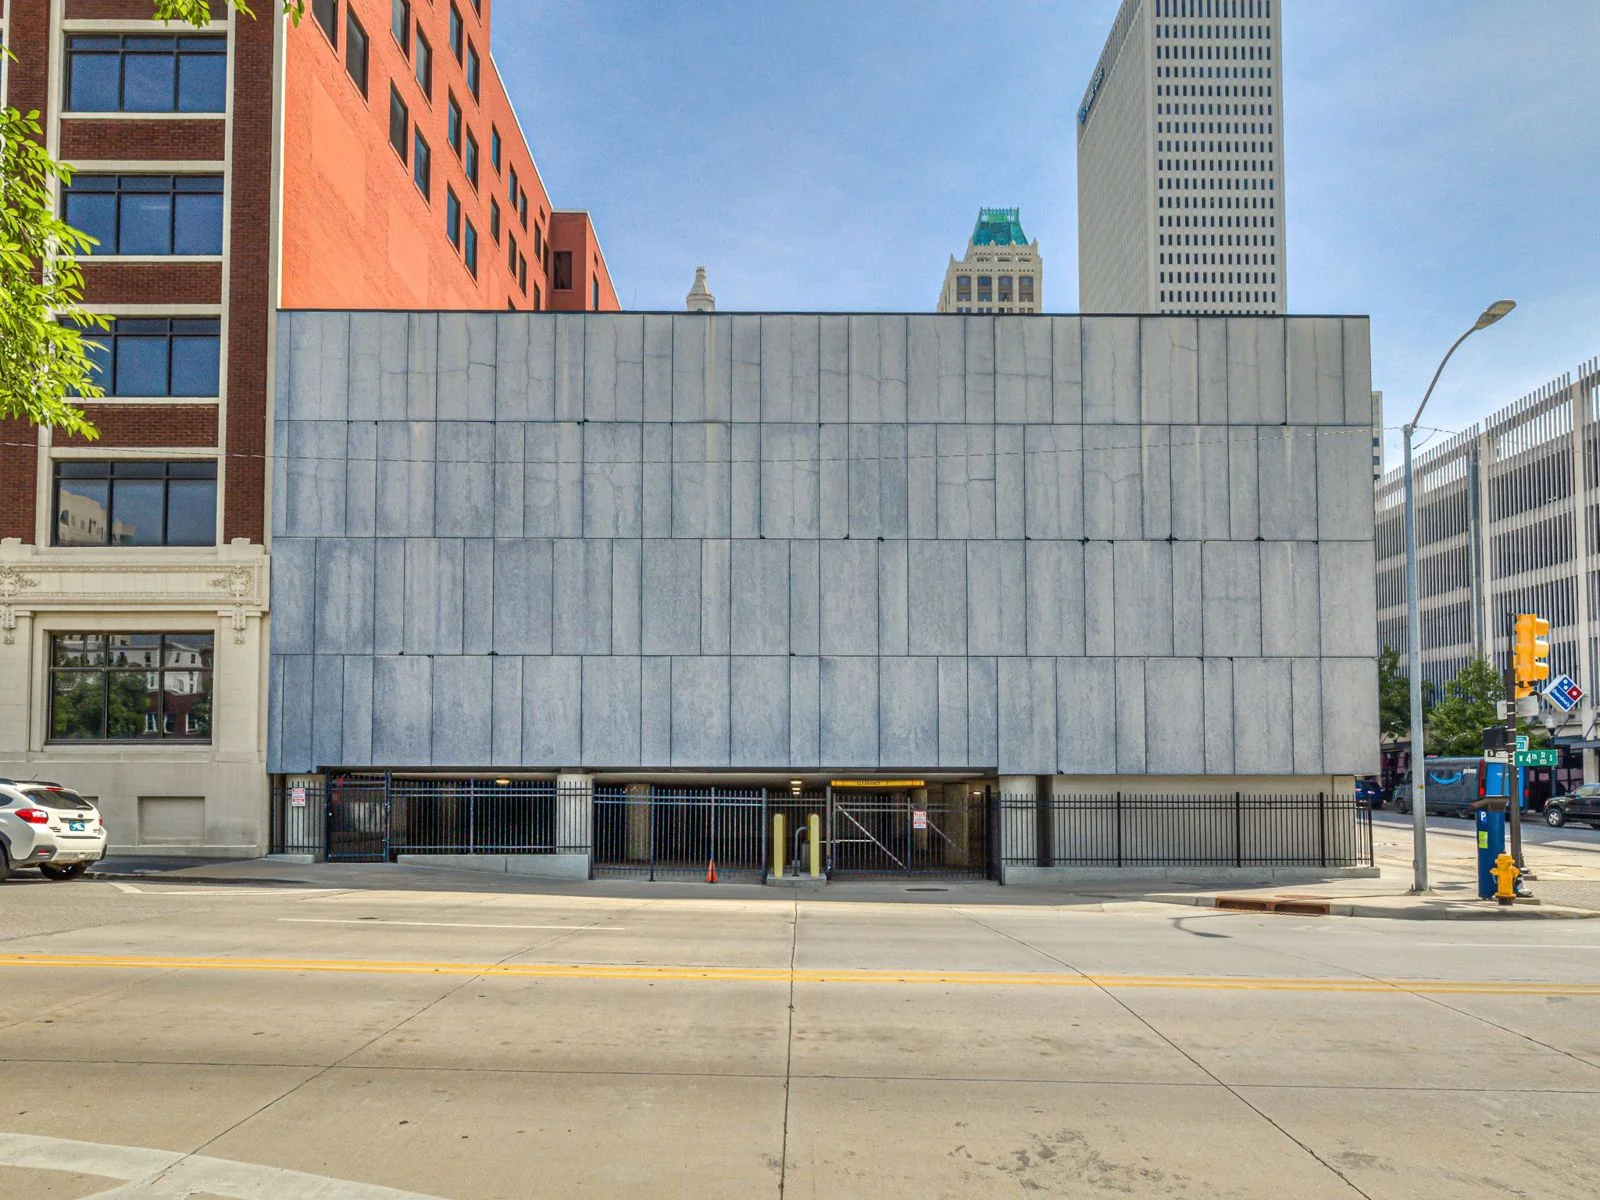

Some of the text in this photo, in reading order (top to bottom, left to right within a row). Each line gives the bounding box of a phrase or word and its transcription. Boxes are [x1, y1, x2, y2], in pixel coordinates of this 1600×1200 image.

[1526, 753, 1538, 764] 4th
[1463, 767, 1477, 775] prime
[1480, 811, 1487, 821] P
